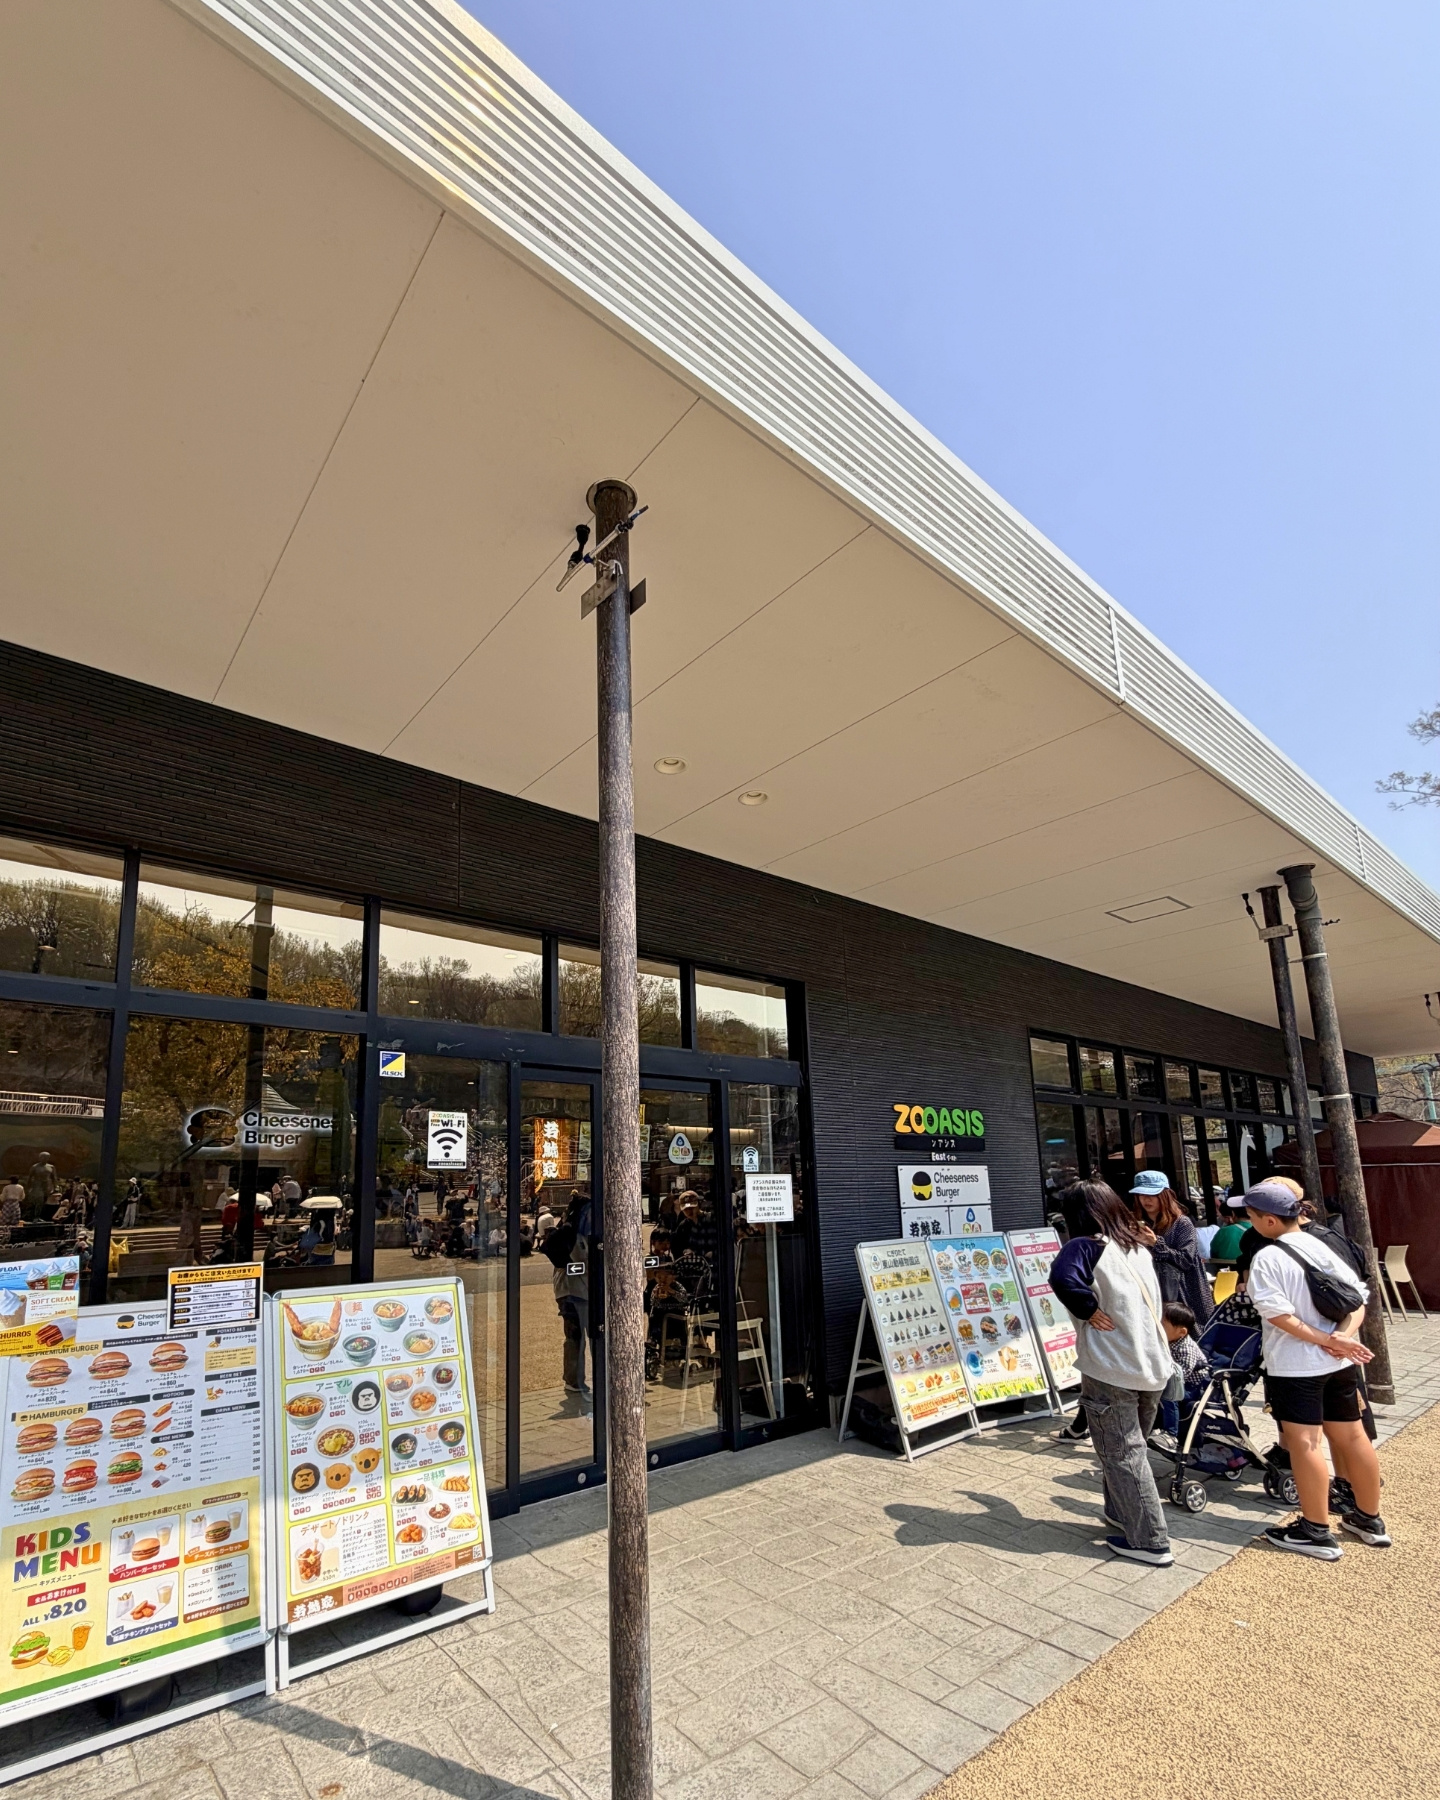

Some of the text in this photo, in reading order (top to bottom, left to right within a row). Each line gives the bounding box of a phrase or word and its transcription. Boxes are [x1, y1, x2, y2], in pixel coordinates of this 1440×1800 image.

[441, 1119, 465, 1128] Wi-Fi
[893, 1104, 985, 1137] ZOOASIS
[244, 1130, 302, 1148] Burger
[931, 1152, 946, 1161] East
[933, 1171, 979, 1184] Cheeseness
[935, 1186, 960, 1199] Burger
[886, 1249, 907, 1258] にぎりたて
[1021, 1246, 1032, 1254] CONE
[882, 1255, 921, 1270] 東山動植物園店
[31, 1295, 76, 1305] SOFT CREAM
[137, 1313, 167, 1321] Cheesen
[137, 1319, 160, 1328] Burger
[35, 1343, 99, 1357] PREMIUM BURGER
[316, 1380, 353, 1392] アニマル
[28, 1407, 84, 1421] HAMBURGER
[416, 1469, 446, 1482] 一品料理
[15, 1521, 91, 1557] KIDS
[194, 1544, 243, 1560] チーズバーガーセット
[13, 1541, 102, 1582] MENU
[214, 1561, 233, 1571] DRINK
[120, 1562, 167, 1578] ハンバーガーセット
[39, 1574, 76, 1586] キッズメニュー
[22, 1598, 87, 1627] ALL ¥820
